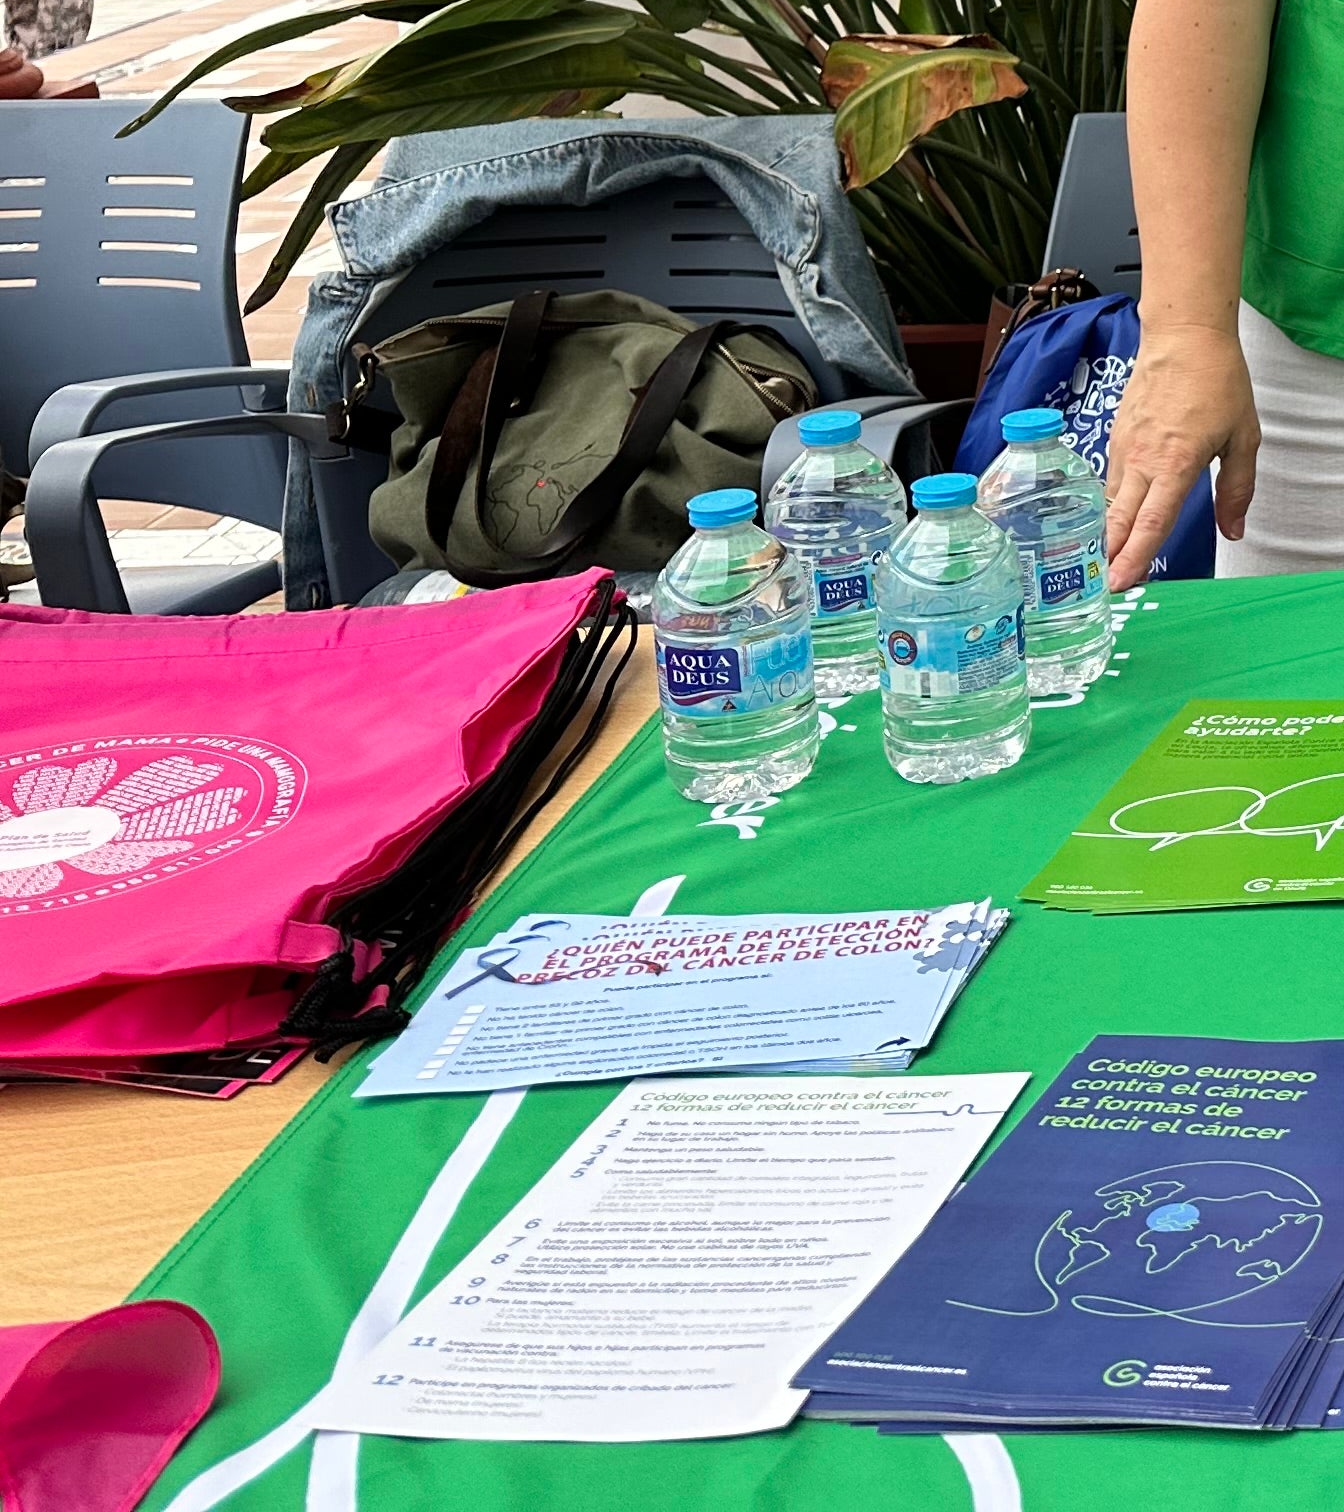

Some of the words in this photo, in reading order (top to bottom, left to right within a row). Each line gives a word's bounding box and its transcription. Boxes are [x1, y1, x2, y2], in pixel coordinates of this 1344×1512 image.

[1045, 569, 1081, 584] AQUA
[824, 579, 863, 592] AQUA
[1046, 578, 1080, 593] DEUS
[825, 589, 862, 601] DEUS
[670, 654, 732, 670] AQUA
[673, 670, 730, 686] DEUS
[1192, 715, 1277, 726] ¿Cómo
[1184, 726, 1312, 737] ayudarte?
[52, 744, 86, 756] DE
[94, 737, 171, 749] MAMA
[191, 737, 240, 750] PIDE
[238, 744, 274, 759] UNA
[551, 939, 644, 959] ¿QUIÉN
[652, 933, 733, 950] PUEDE
[745, 919, 889, 941] PARTICIPAR
[897, 914, 929, 926] EN
[543, 958, 578, 970] EL
[580, 944, 728, 967] PROGRAMA
[737, 940, 771, 953] DE
[779, 928, 923, 950] DETECCIÓN
[516, 967, 616, 984] PRECOZ
[683, 953, 785, 971] CÁNCER
[793, 949, 827, 962] DE
[835, 938, 935, 956] COLON?
[1088, 1058, 1189, 1078] Código
[1194, 1067, 1317, 1084] europeo
[641, 1091, 707, 1103] Código
[713, 1092, 794, 1103] europeo
[799, 1091, 859, 1100] contra
[865, 1090, 881, 1099] el
[887, 1089, 952, 1100] cáncer
[1071, 1078, 1164, 1092] contra
[1171, 1081, 1200, 1096] el
[1204, 1084, 1308, 1102] cáncer
[630, 1104, 650, 1112] 12
[655, 1102, 722, 1113] formas
[728, 1102, 753, 1111] de
[758, 1102, 828, 1111] reducir
[832, 1102, 849, 1110] el
[856, 1101, 919, 1110] cáncer
[1054, 1096, 1090, 1108] 12
[1094, 1096, 1198, 1115] formas
[1203, 1102, 1243, 1117] de
[616, 1118, 628, 1126] 1
[1038, 1114, 1148, 1131] reducir
[1151, 1118, 1179, 1133] el
[1184, 1121, 1290, 1140] cáncer
[591, 1145, 607, 1155] 3
[581, 1157, 597, 1166] 4
[570, 1168, 587, 1178] 5
[524, 1218, 542, 1229] 6
[506, 1237, 527, 1247] 7
[491, 1254, 509, 1264] 8
[468, 1277, 486, 1288] 9
[450, 1296, 481, 1305] 10
[409, 1337, 437, 1346] 11
[1154, 1365, 1213, 1374] asociación
[372, 1375, 404, 1385] 12
[1143, 1380, 1179, 1388] contra
[1192, 1382, 1231, 1391] cáncer
